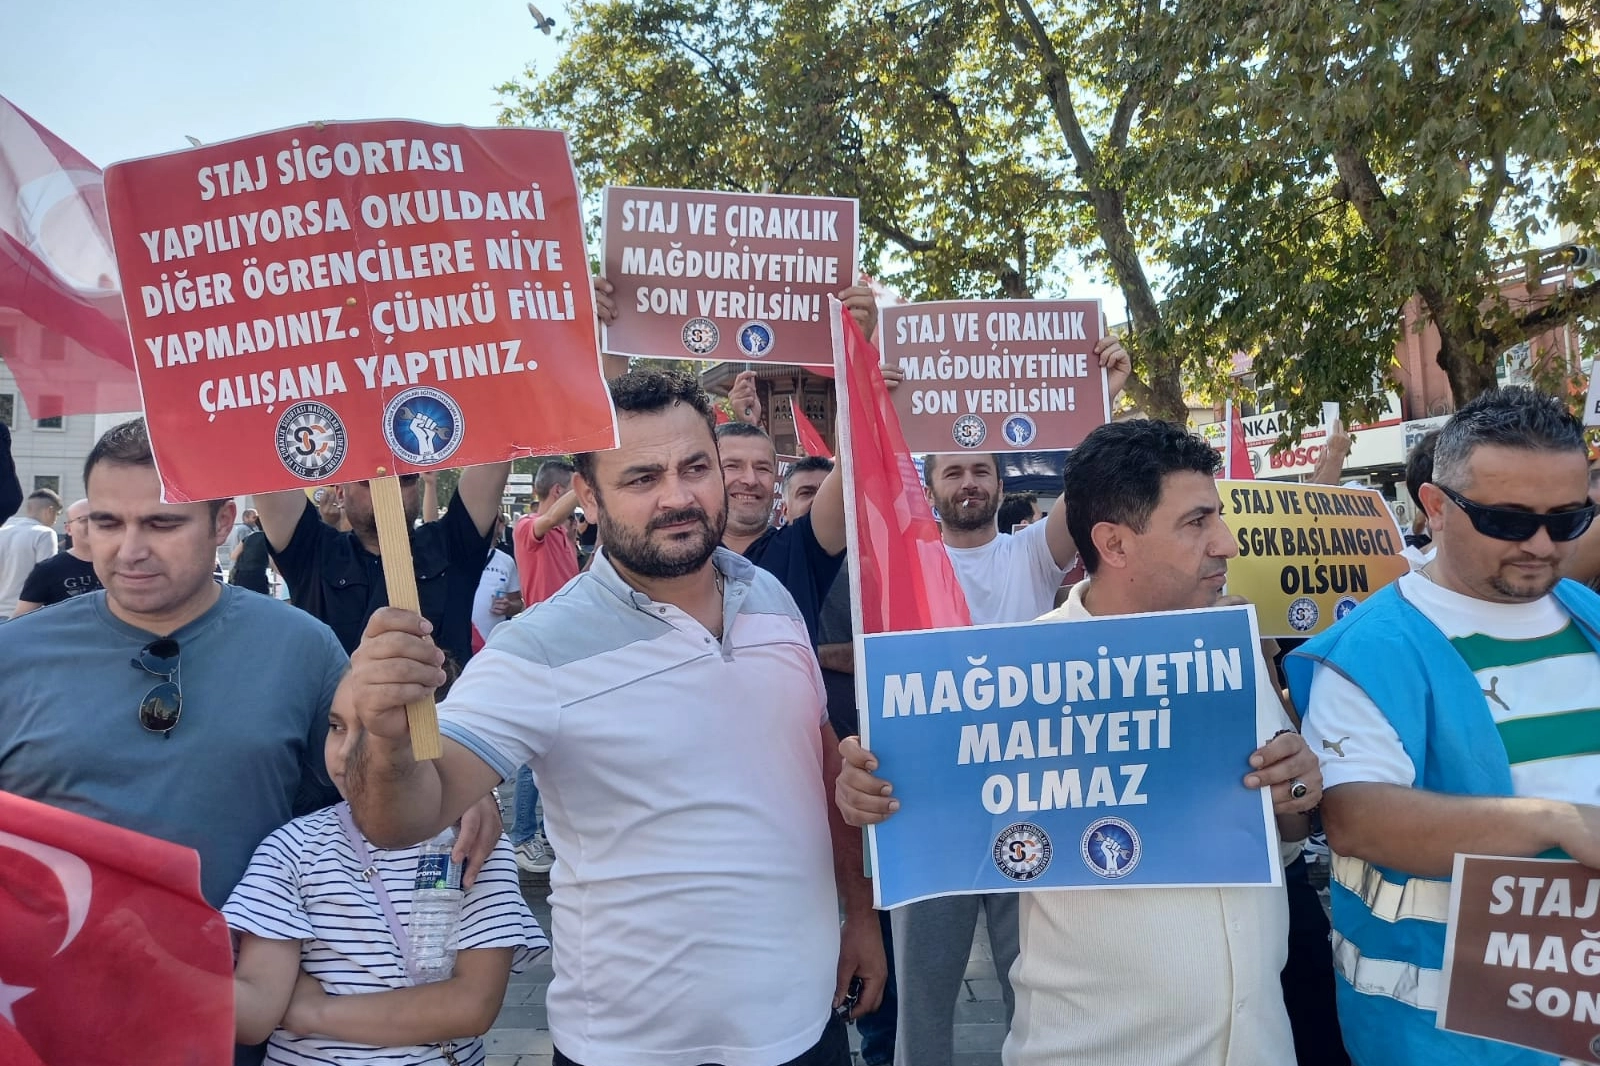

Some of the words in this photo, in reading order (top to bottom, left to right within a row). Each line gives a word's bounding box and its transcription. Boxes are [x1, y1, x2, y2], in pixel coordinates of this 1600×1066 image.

[198, 156, 266, 201] STAJ
[279, 139, 464, 183] SİGORTASI
[140, 199, 350, 263] YAPILIYORSA
[361, 182, 546, 228] OKULDAKİ
[621, 199, 678, 234] STAJ
[687, 202, 718, 237] VE
[724, 204, 839, 248] ÇIRAKLIK
[141, 272, 233, 318] DİĞER
[487, 230, 563, 272] NİYE
[620, 241, 839, 285] MAĞDURİYETİNE
[145, 306, 359, 368] YAPMADINIZ.
[372, 283, 496, 344] ÇÜNKÜ
[508, 281, 576, 321] FİİLİ
[635, 286, 688, 316] SON
[695, 284, 821, 323] VERİLSİN!
[896, 312, 947, 345] STAJ
[952, 312, 979, 343] VE
[986, 310, 1086, 350] ÇIRAKLIK
[198, 361, 347, 423] ÇALIŞANA
[354, 340, 538, 388] YAPTINIZ.
[898, 347, 1088, 381] MAĞDURİYETİNE
[911, 389, 958, 415] SON
[963, 381, 1076, 414] VERİLSİN!
[1231, 488, 1274, 515] STAJ
[1278, 490, 1300, 514] VE
[1304, 491, 1382, 526] ÇIRAKLIK
[1238, 527, 1279, 556] SGK
[1283, 528, 1395, 564] BAŞLANGICI
[1280, 564, 1369, 595] OLSUN
[882, 639, 1243, 718] MAĞDURİYETİN
[957, 699, 1171, 765] MALİYETİ
[981, 764, 1149, 815] OLMAZ
[1488, 875, 1600, 919] STAJ
[1506, 983, 1600, 1025] SON
